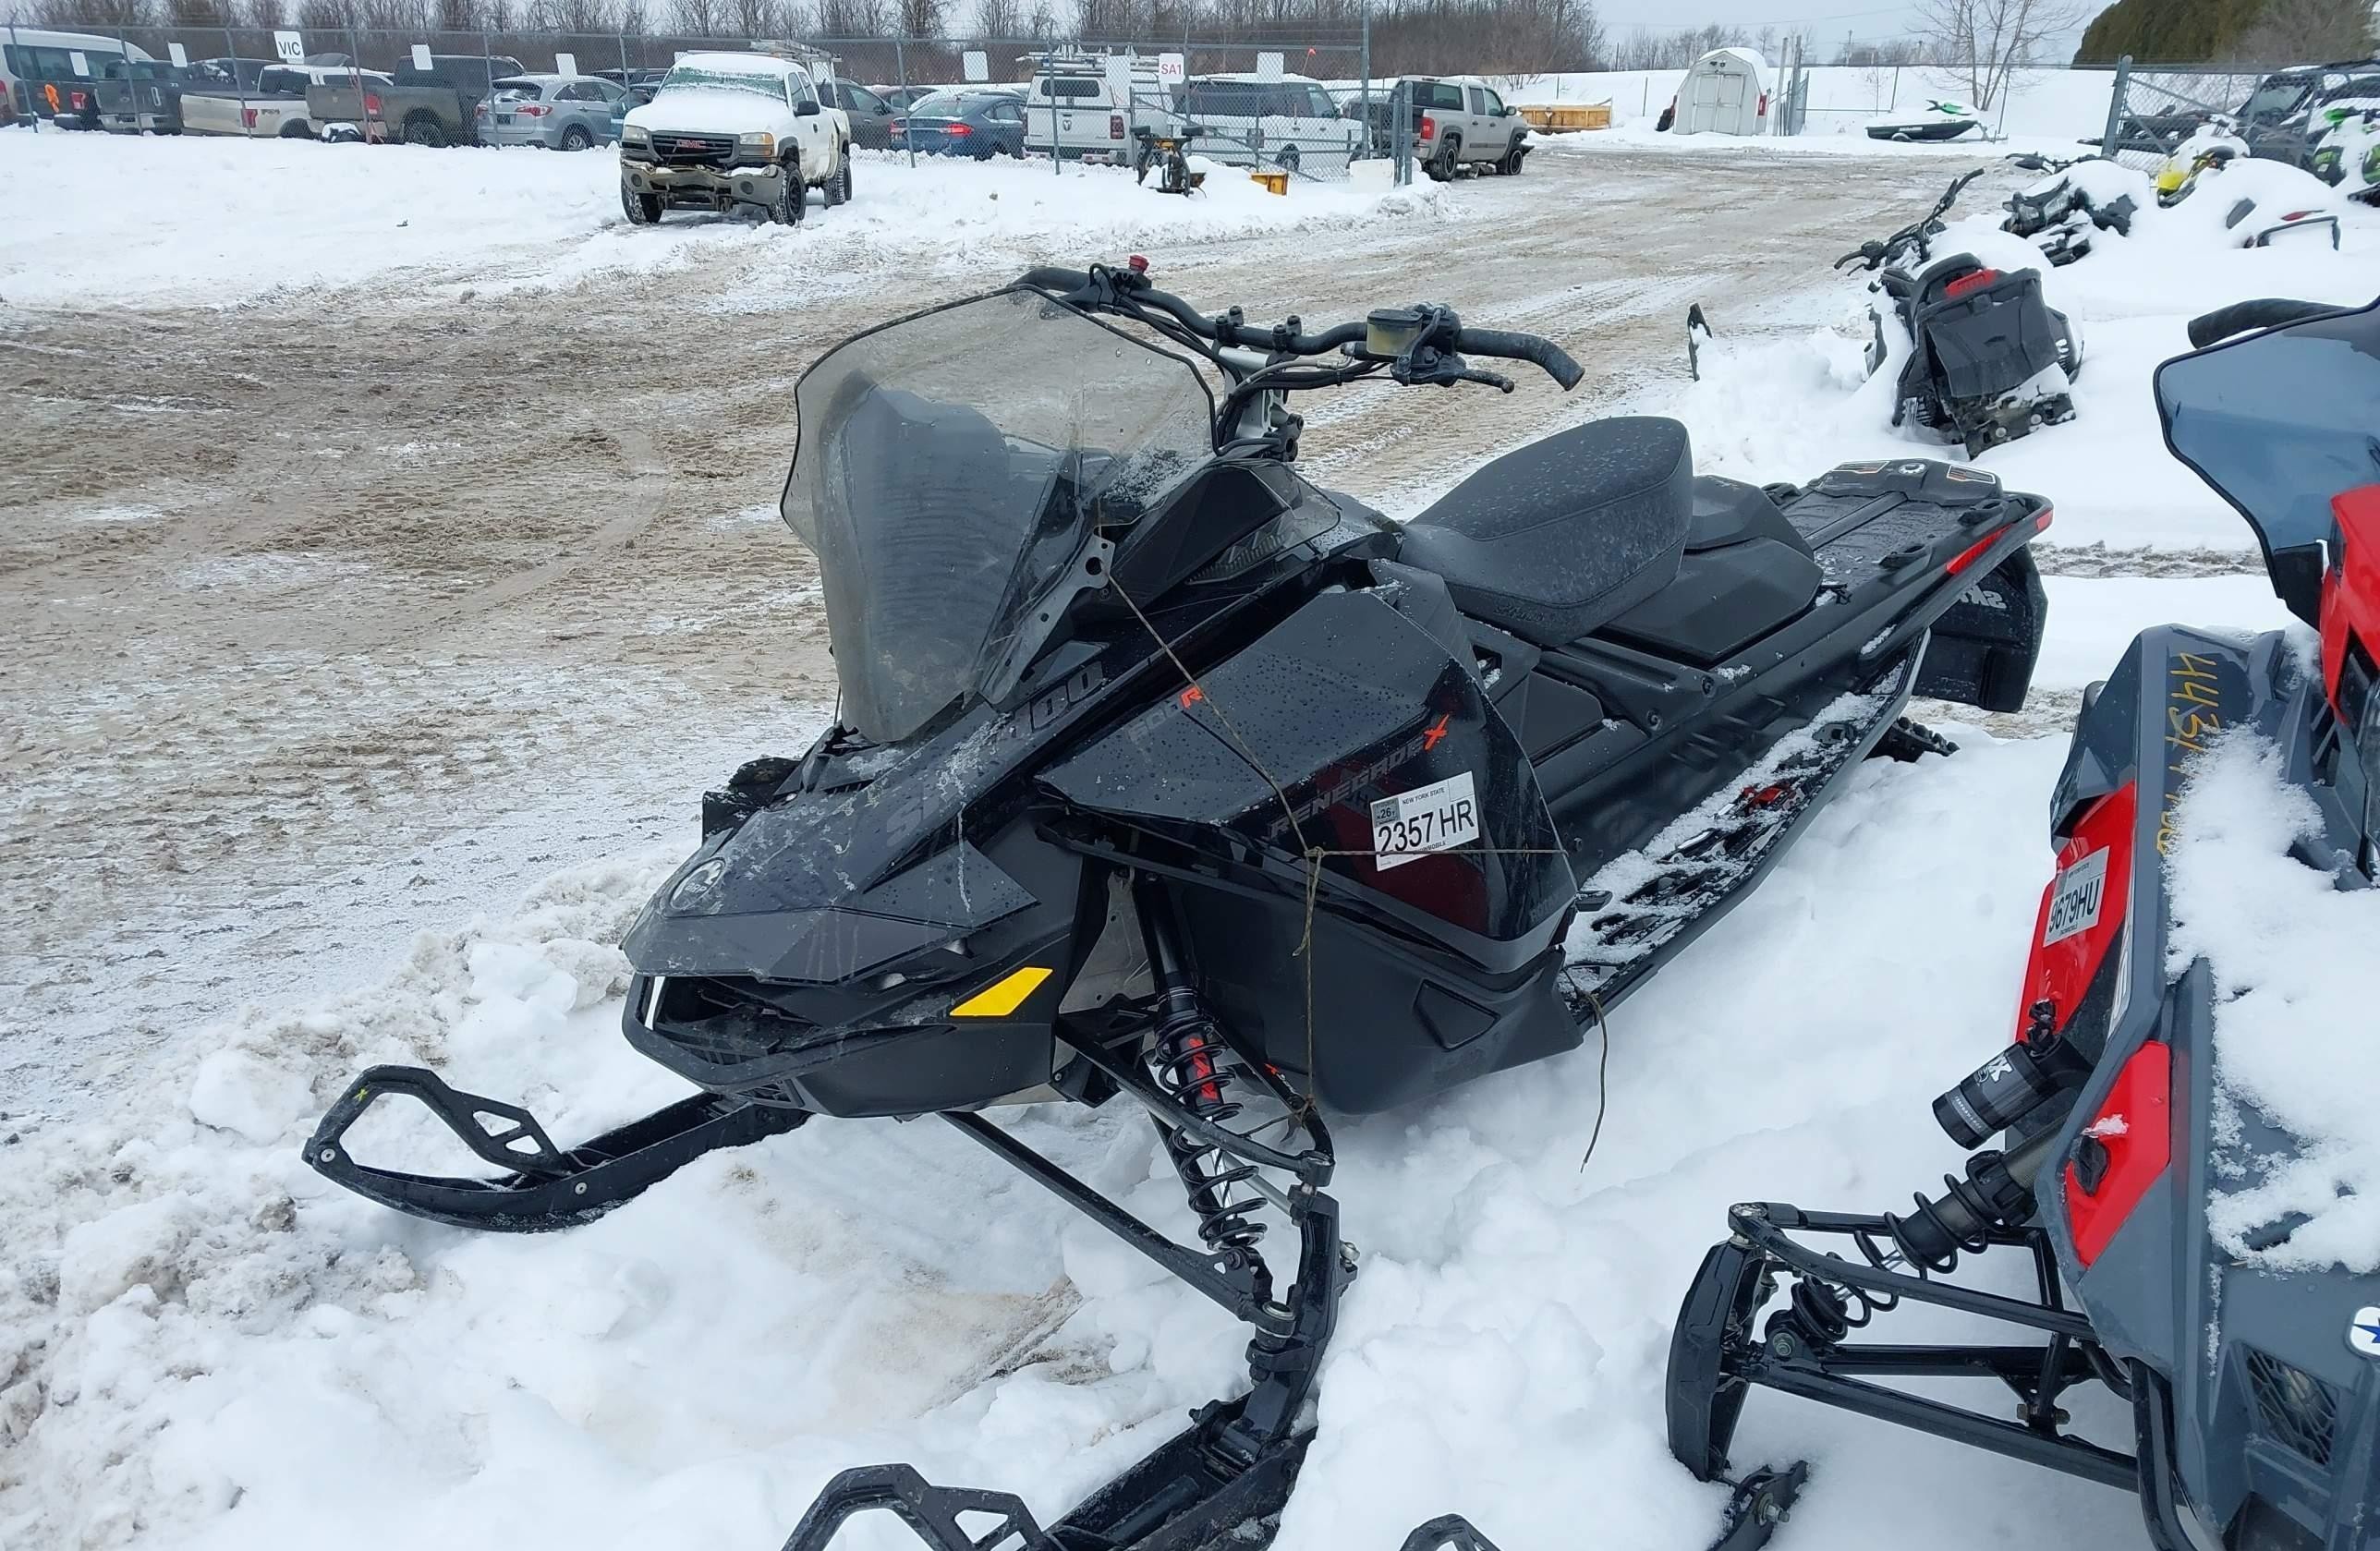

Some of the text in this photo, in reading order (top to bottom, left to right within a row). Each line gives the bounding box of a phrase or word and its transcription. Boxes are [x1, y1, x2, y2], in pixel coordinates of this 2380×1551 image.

[278, 41, 301, 56] VIC
[1160, 64, 1182, 75] SA1
[676, 139, 707, 149] GMC
[1402, 796, 1415, 805] NEW
[1415, 793, 1429, 801] YORK
[1430, 787, 1445, 797] STATE
[2048, 878, 2101, 933] 9679HU
